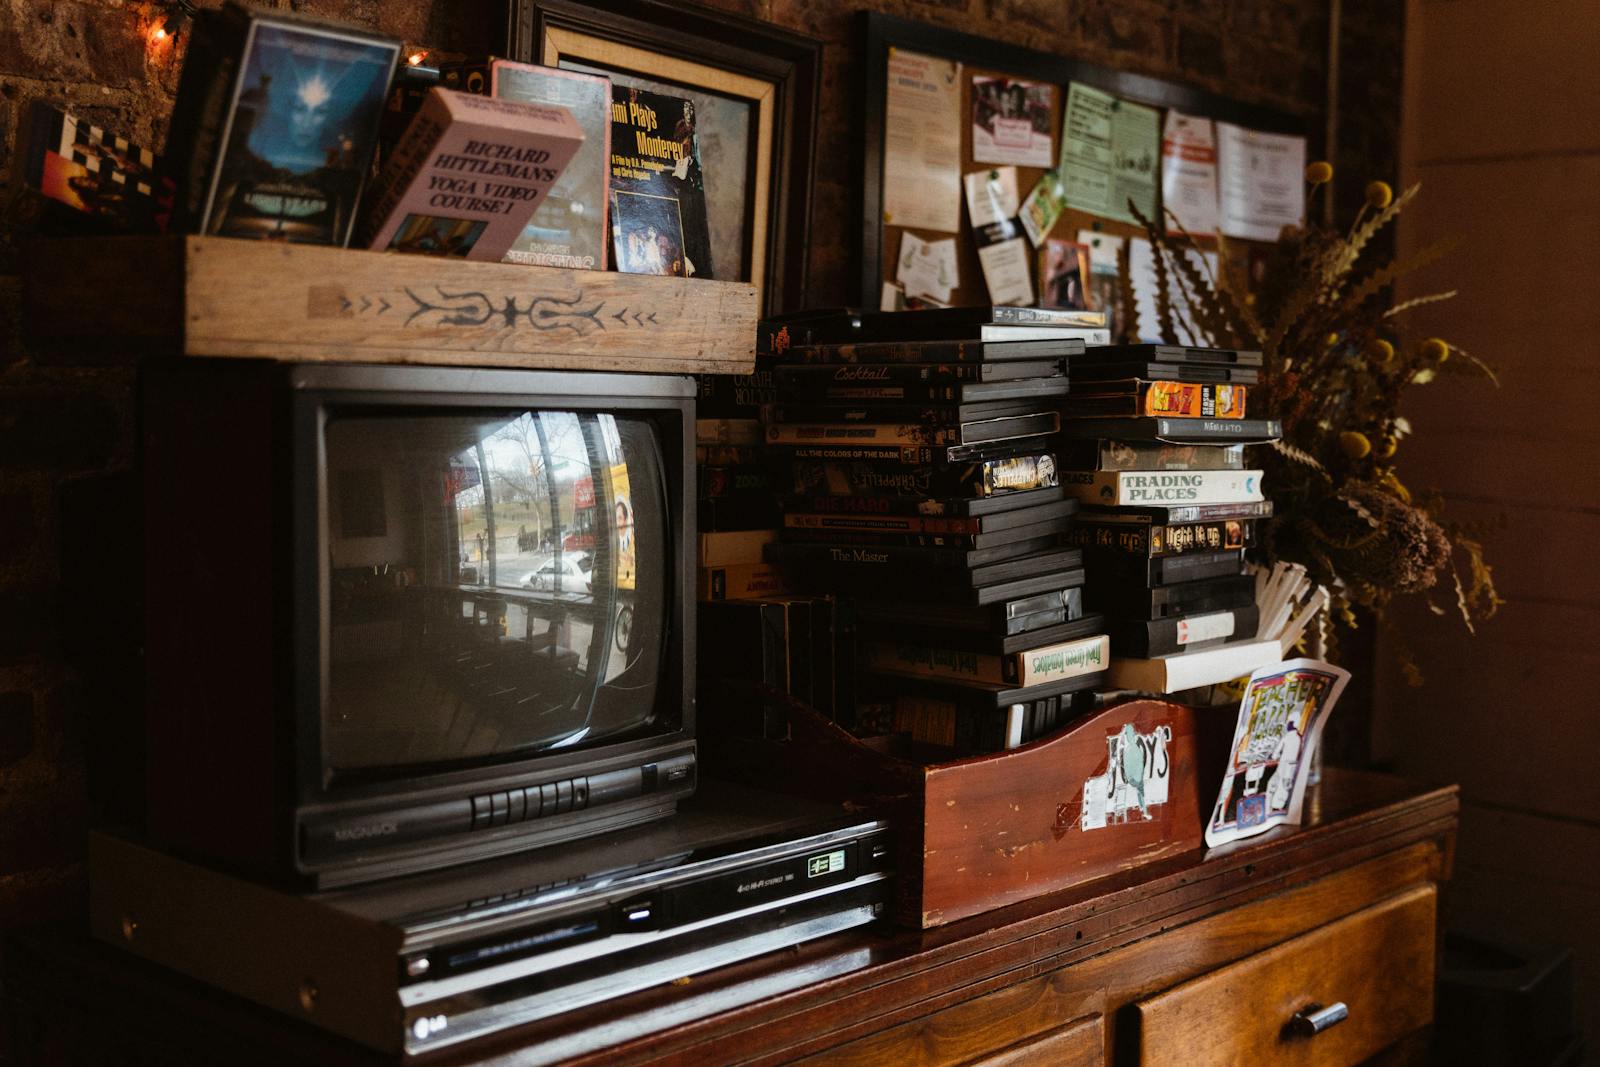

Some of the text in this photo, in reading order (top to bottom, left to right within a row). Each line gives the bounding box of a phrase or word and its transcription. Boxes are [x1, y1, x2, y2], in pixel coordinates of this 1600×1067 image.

[611, 100, 658, 132] imi Plays
[463, 140, 551, 164] RICHARD
[636, 130, 685, 162] Monterey
[428, 175, 538, 201] YOGA VIDEO
[429, 193, 515, 215] COURSE 1
[833, 366, 890, 381] Cocktail
[795, 449, 899, 459] ALL THE COLORS OF THE DARK
[1062, 473, 1094, 485] PLACES
[1122, 475, 1203, 488] TRADING
[1130, 487, 1198, 501] PLACES
[816, 496, 889, 512] DIE HARD
[1165, 525, 1221, 553] light it up
[830, 548, 889, 563] The Master
[1032, 644, 1101, 677] Fried Green Tomatoes
